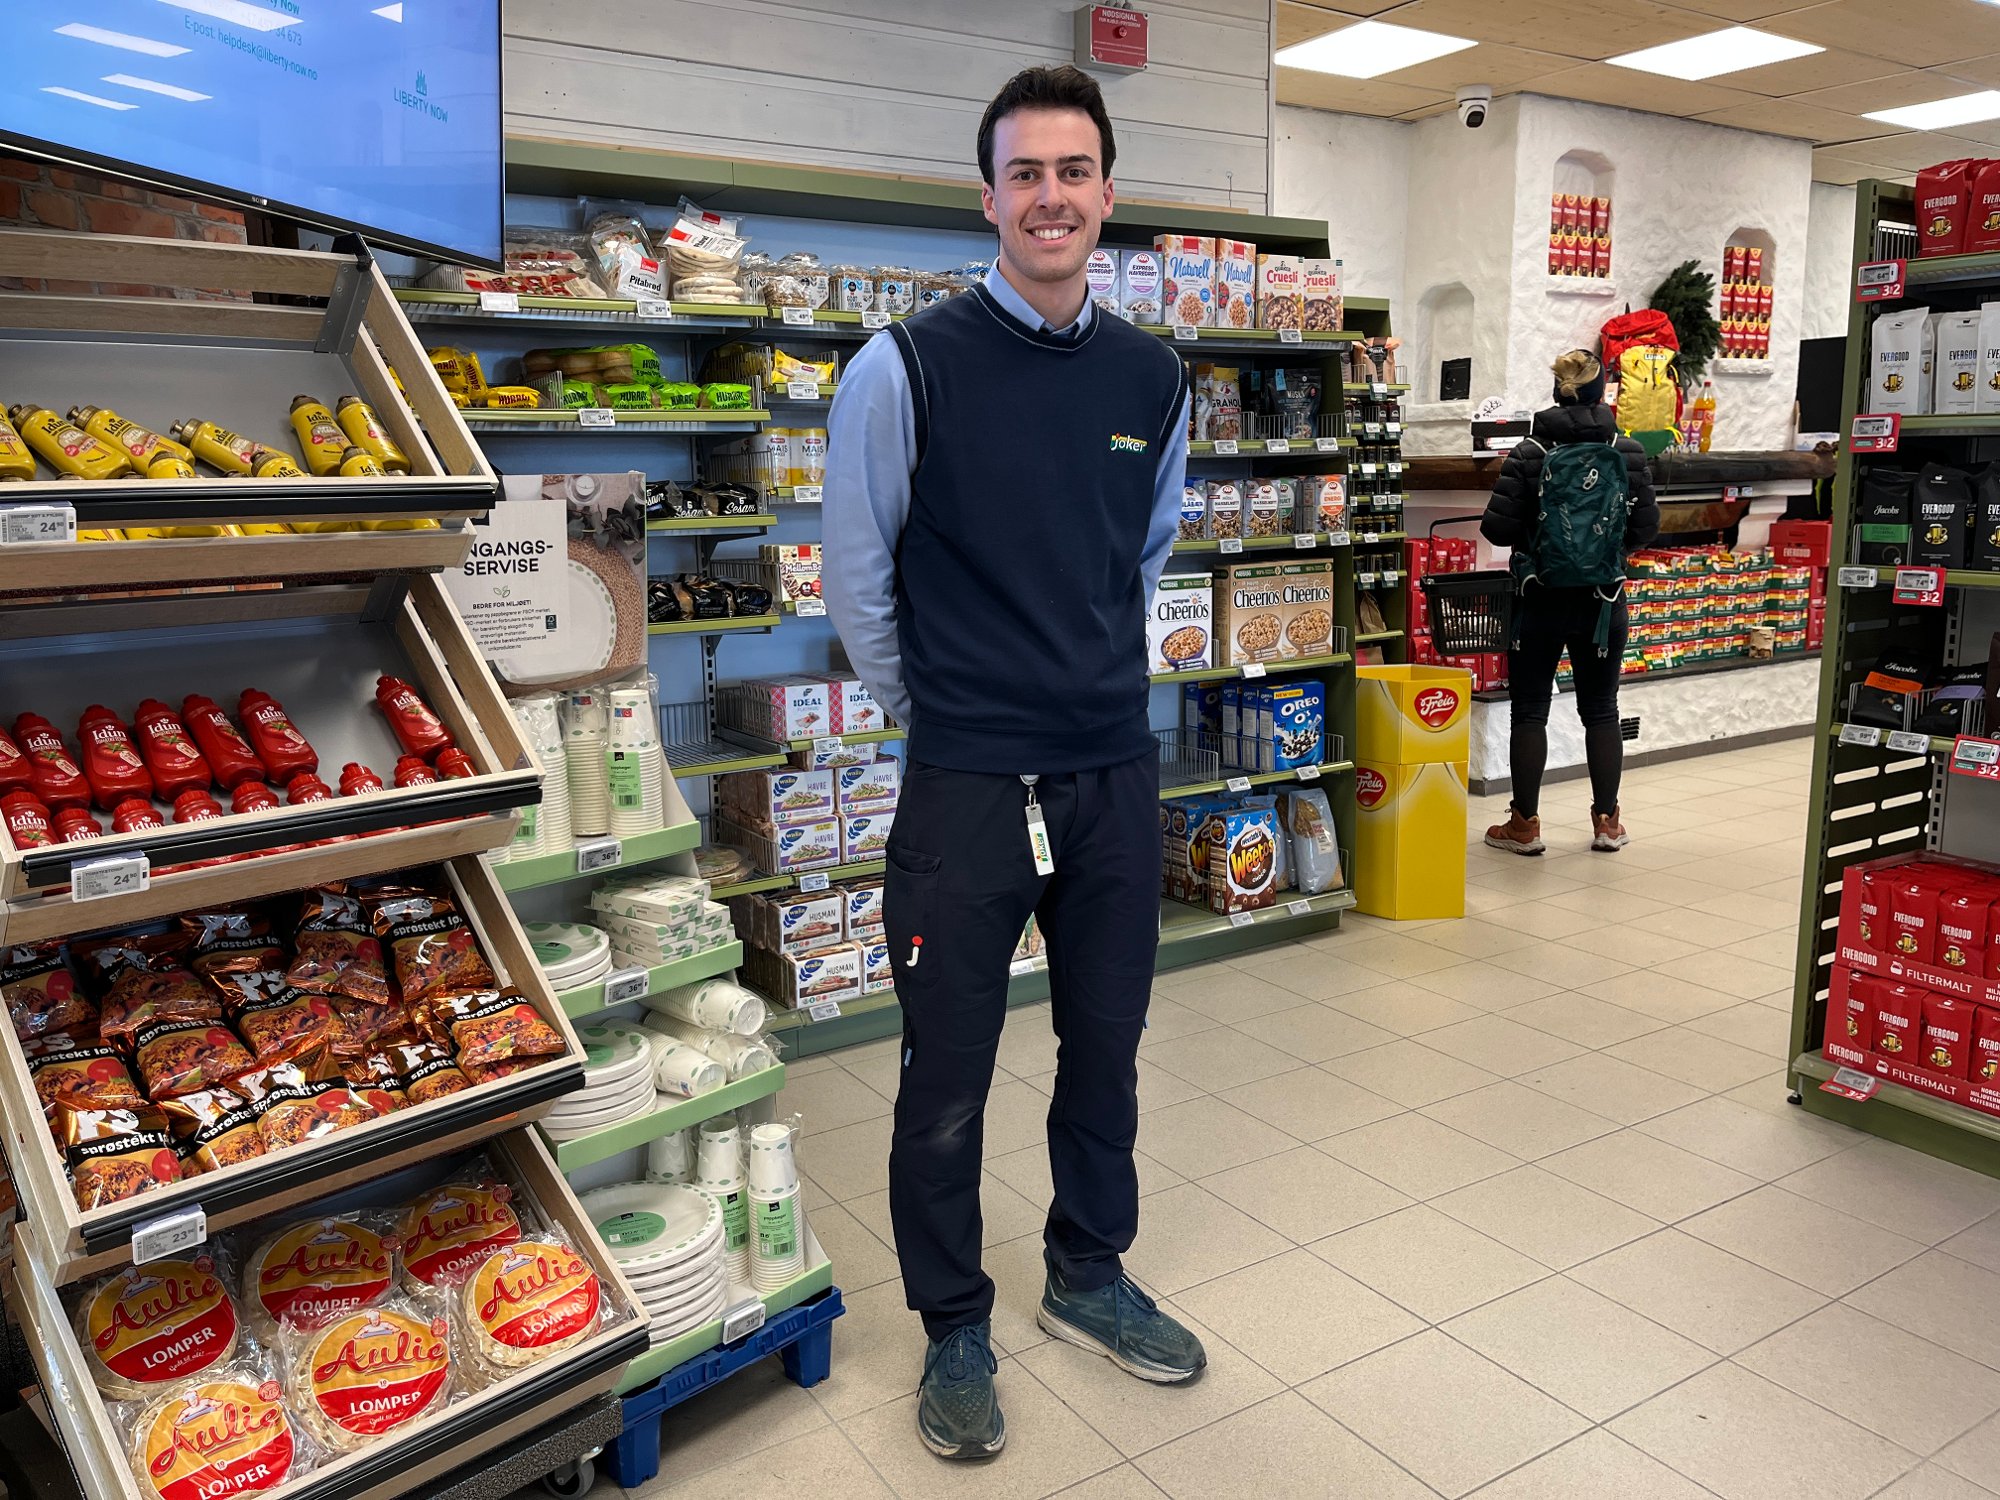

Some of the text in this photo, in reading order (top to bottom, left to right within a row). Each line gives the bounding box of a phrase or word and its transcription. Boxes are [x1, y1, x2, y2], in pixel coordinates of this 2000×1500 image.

[281, 0, 300, 15] Now
[394, 87, 448, 124] LIBERTY NOW
[1923, 195, 1957, 209] EVERGOOD
[1169, 256, 1211, 280] Naturell
[629, 275, 661, 292] Pitabrød
[1266, 270, 1298, 283] Cruesli
[1882, 284, 1900, 296] 3 2
[1880, 351, 1910, 362] EVERGOOD
[1949, 350, 1977, 360] EVERGOO
[498, 393, 530, 405] HURRA!
[306, 413, 332, 423] Idun
[802, 444, 824, 453] MAIS
[1111, 433, 1146, 452] joker
[1876, 437, 1895, 448] 3 2
[739, 496, 745, 504] 6
[725, 502, 756, 515] Sesam
[1874, 504, 1900, 515] Jacobs
[1921, 503, 1956, 514] EVERGOOD
[40, 522, 56, 533] 24
[470, 540, 554, 558] NGANGS-
[463, 558, 540, 576] SERVISE
[1234, 590, 1280, 609] Cheerios
[1283, 584, 1330, 604] Cheerios
[1920, 591, 1940, 603] 3 2
[1157, 601, 1209, 621] Cheerios
[1885, 662, 1918, 674] Jacobs
[793, 698, 823, 707] IDEAL
[849, 693, 873, 702] IDEA
[1420, 690, 1455, 716] Freia
[1281, 696, 1319, 717] OREO
[256, 710, 286, 720] Idun
[92, 729, 127, 741] Idun
[148, 722, 181, 735] Idun
[27, 735, 62, 748] Idun
[1978, 763, 1999, 777] 3 2
[873, 774, 893, 784] HAVRE
[807, 782, 828, 791] HAVRE
[10, 814, 47, 827] Idun
[65, 830, 101, 842] Idun
[814, 833, 835, 844] HAVRE
[1230, 838, 1275, 884] Weetos
[114, 873, 130, 886] 24
[809, 908, 836, 922] HUSMAN
[1894, 911, 1925, 928] EVERGOOD
[393, 918, 447, 936] sprøstekt
[1941, 923, 1973, 941] EVERGOOD
[1842, 946, 1878, 967] EVERGOOD
[825, 962, 854, 976] HUSMAN
[628, 981, 639, 992] 36
[1906, 968, 1973, 993] FILTERMALT
[1879, 1010, 1909, 1028] EVERGOOD
[139, 1020, 205, 1043] sprøstekt
[1926, 1025, 1960, 1042] EVERGOOD
[28, 1048, 87, 1069] prøstekt
[1829, 1043, 1864, 1065] EVERGOOD
[1892, 1068, 1958, 1096] FILTERMALT
[81, 1134, 155, 1155] sprøstekt
[403, 1203, 511, 1255] Aulie
[173, 1230, 188, 1243] 23
[261, 1239, 388, 1284] Aulie
[480, 1256, 586, 1322] Aulie
[291, 1296, 361, 1313] LOMPER
[94, 1276, 218, 1350] Aulie
[143, 1326, 217, 1370] LOMPER
[314, 1332, 448, 1384] Aulie
[150, 1402, 283, 1478] Aulie
